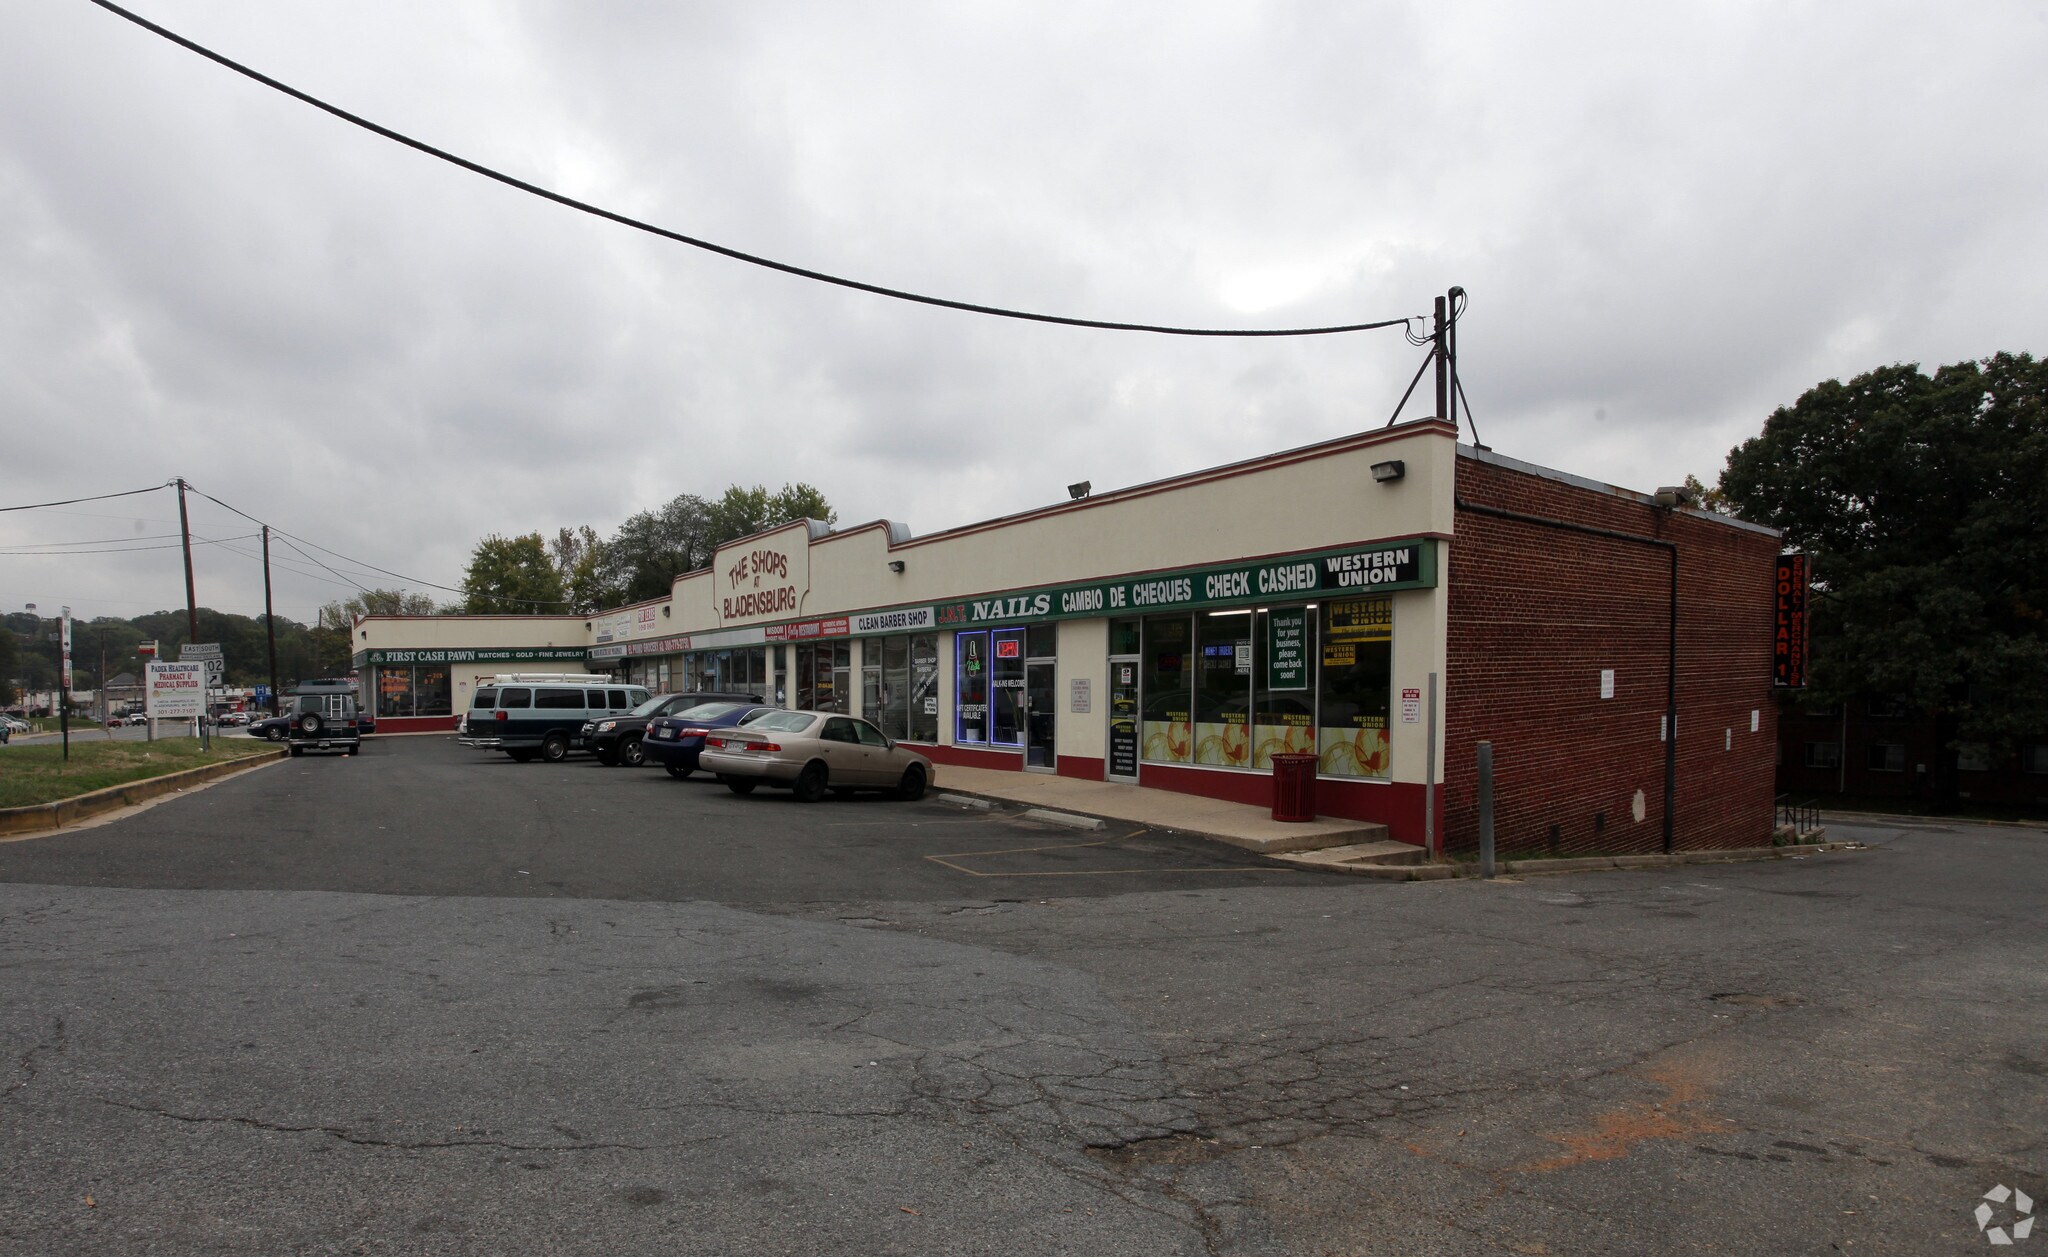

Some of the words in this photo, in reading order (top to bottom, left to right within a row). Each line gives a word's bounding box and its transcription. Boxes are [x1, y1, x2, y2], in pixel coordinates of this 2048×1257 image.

[1327, 549, 1410, 572] WESTERN
[729, 556, 748, 590] THE
[751, 550, 788, 580] SHOPS
[753, 576, 760, 588] AT
[1205, 571, 1250, 599] CHECK
[1258, 563, 1316, 593] CASHED
[1338, 566, 1397, 587] UNION
[1792, 555, 1804, 604] GENERAL
[1061, 589, 1103, 612] CAMBIO
[1109, 586, 1126, 607] DE
[1132, 578, 1192, 605] CHEQUES
[723, 585, 797, 620] BLADENSBURG
[938, 605, 967, 623] J.N.T.
[971, 594, 1051, 621] NAILS
[1333, 601, 1392, 614] WESTERN
[1777, 567, 1791, 655] DOLLAR
[858, 616, 879, 631] CLEAN
[879, 612, 907, 629] BARBER
[908, 610, 928, 626] SHOP
[1273, 617, 1290, 627] Thank
[1291, 618, 1302, 629] you
[1351, 612, 1392, 625] UNION
[766, 625, 784, 635] WISDOM
[1277, 629, 1287, 637] for
[1288, 629, 1300, 640] your
[201, 644, 220, 652] SOUTH
[1276, 638, 1301, 648] business,
[1790, 611, 1803, 687] MERCHANDISE
[998, 642, 1018, 657] OPEN
[1279, 649, 1297, 659] please
[386, 651, 416, 662] FIRST
[419, 651, 446, 661] CASH
[447, 650, 475, 661] PAWN
[478, 651, 510, 659] WATCHES
[555, 650, 585, 658] JEWELRY
[168, 664, 200, 672] HEALTHCARE
[1273, 660, 1288, 668] come
[1289, 659, 1302, 668] back
[1778, 663, 1787, 676] 1
[159, 672, 186, 680] PHARMACY
[187, 672, 192, 680] &
[1280, 670, 1296, 679] soon!
[176, 680, 199, 688] SUPPLIES
[1008, 679, 1025, 688] WELCOME
[962, 712, 981, 720] AVAILABLE
